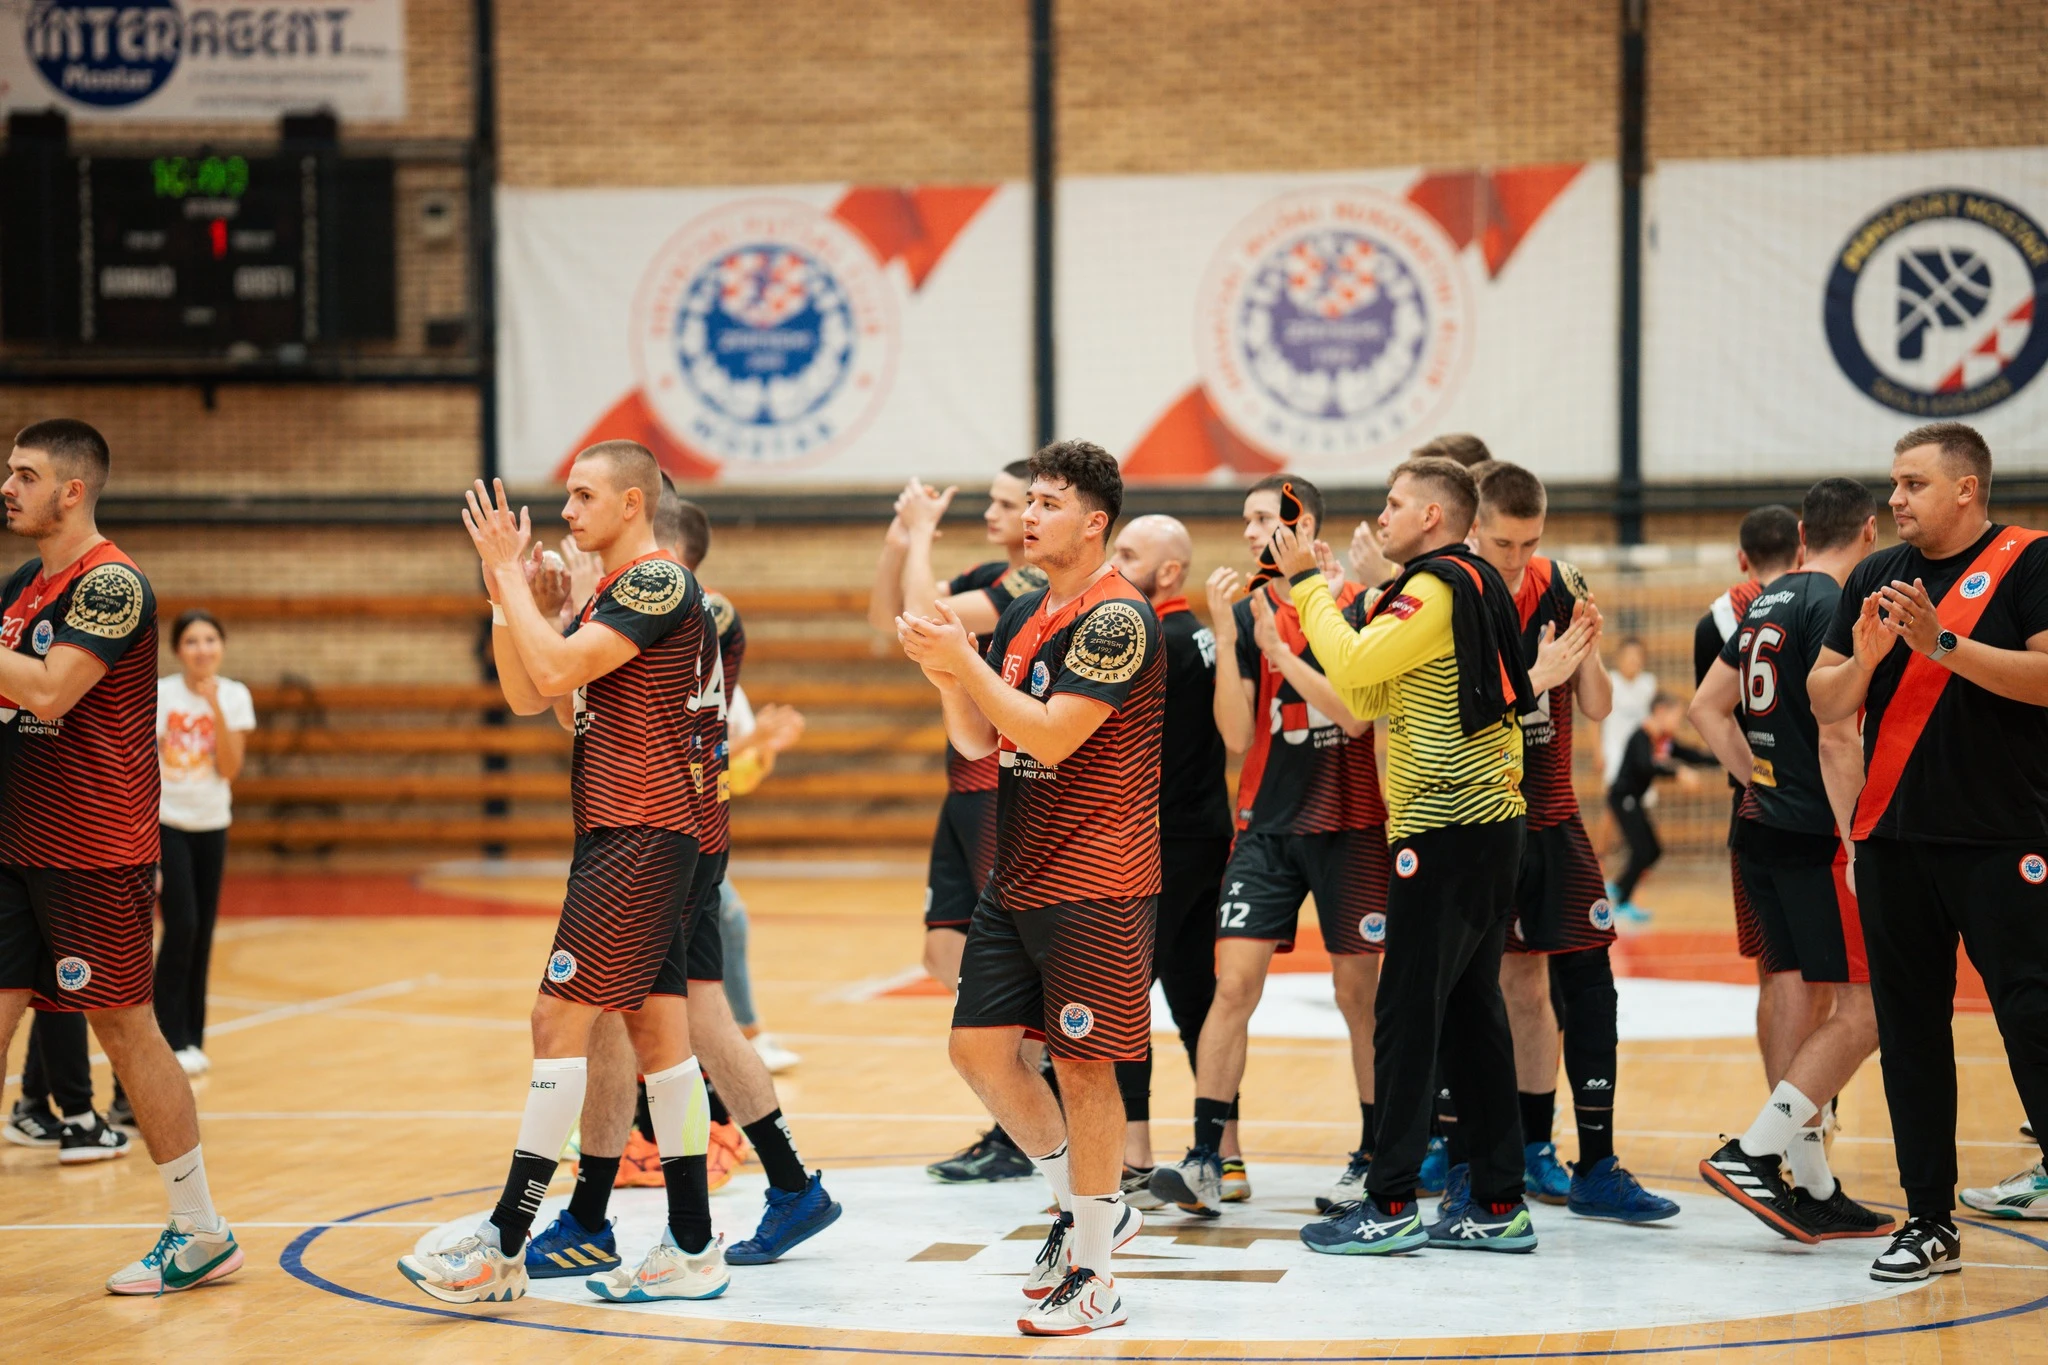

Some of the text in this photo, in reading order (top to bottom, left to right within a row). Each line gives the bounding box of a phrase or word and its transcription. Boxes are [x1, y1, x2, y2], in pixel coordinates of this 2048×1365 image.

[61, 64, 155, 92] Mostar
[1104, 605, 1145, 648] RUKOMETNI
[1071, 661, 1120, 681] MOSTAR
[1220, 901, 1251, 929] 12
